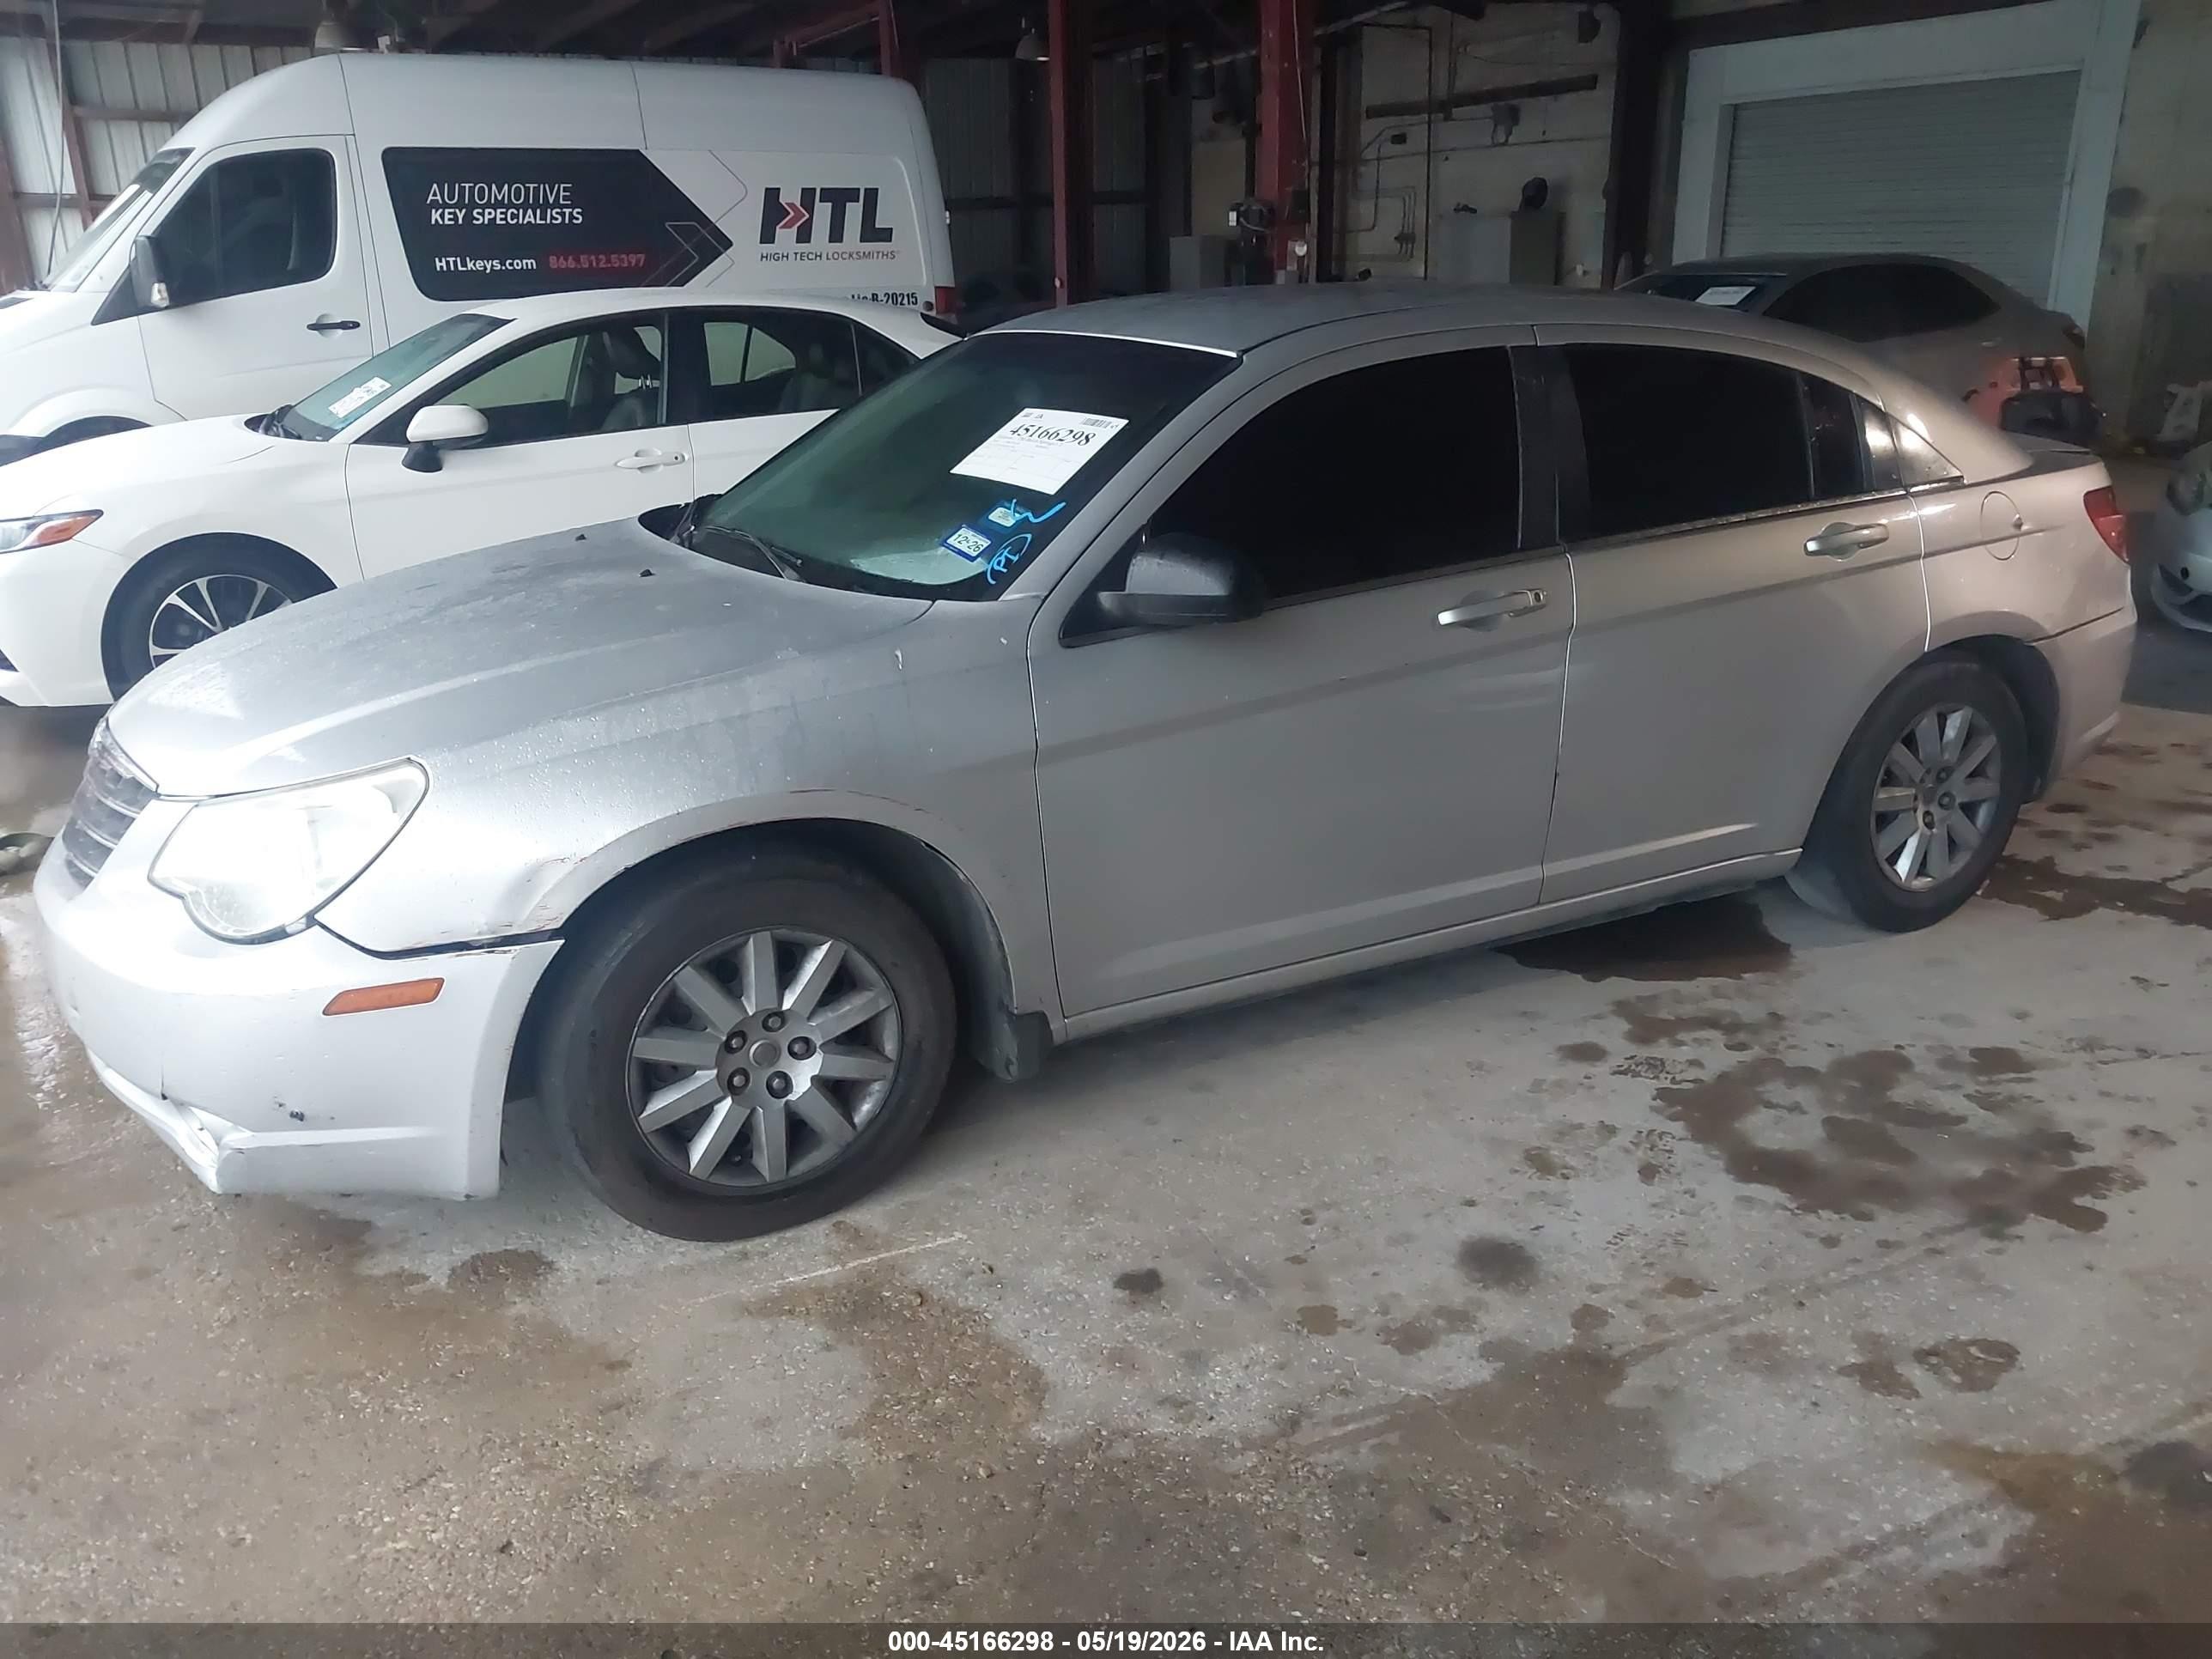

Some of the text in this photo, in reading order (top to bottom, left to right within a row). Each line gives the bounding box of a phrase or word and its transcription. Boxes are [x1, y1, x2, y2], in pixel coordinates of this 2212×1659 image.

[426, 183, 573, 204] AUTOMOTIVE
[430, 208, 583, 225] KEY SPECIALISTS
[759, 187, 894, 244] HTL
[434, 254, 646, 273] HTLkeys.com 866.512.5397
[760, 250, 896, 262] HIGH TECH LOCKSMITHS
[1010, 423, 1096, 446] 45166298
